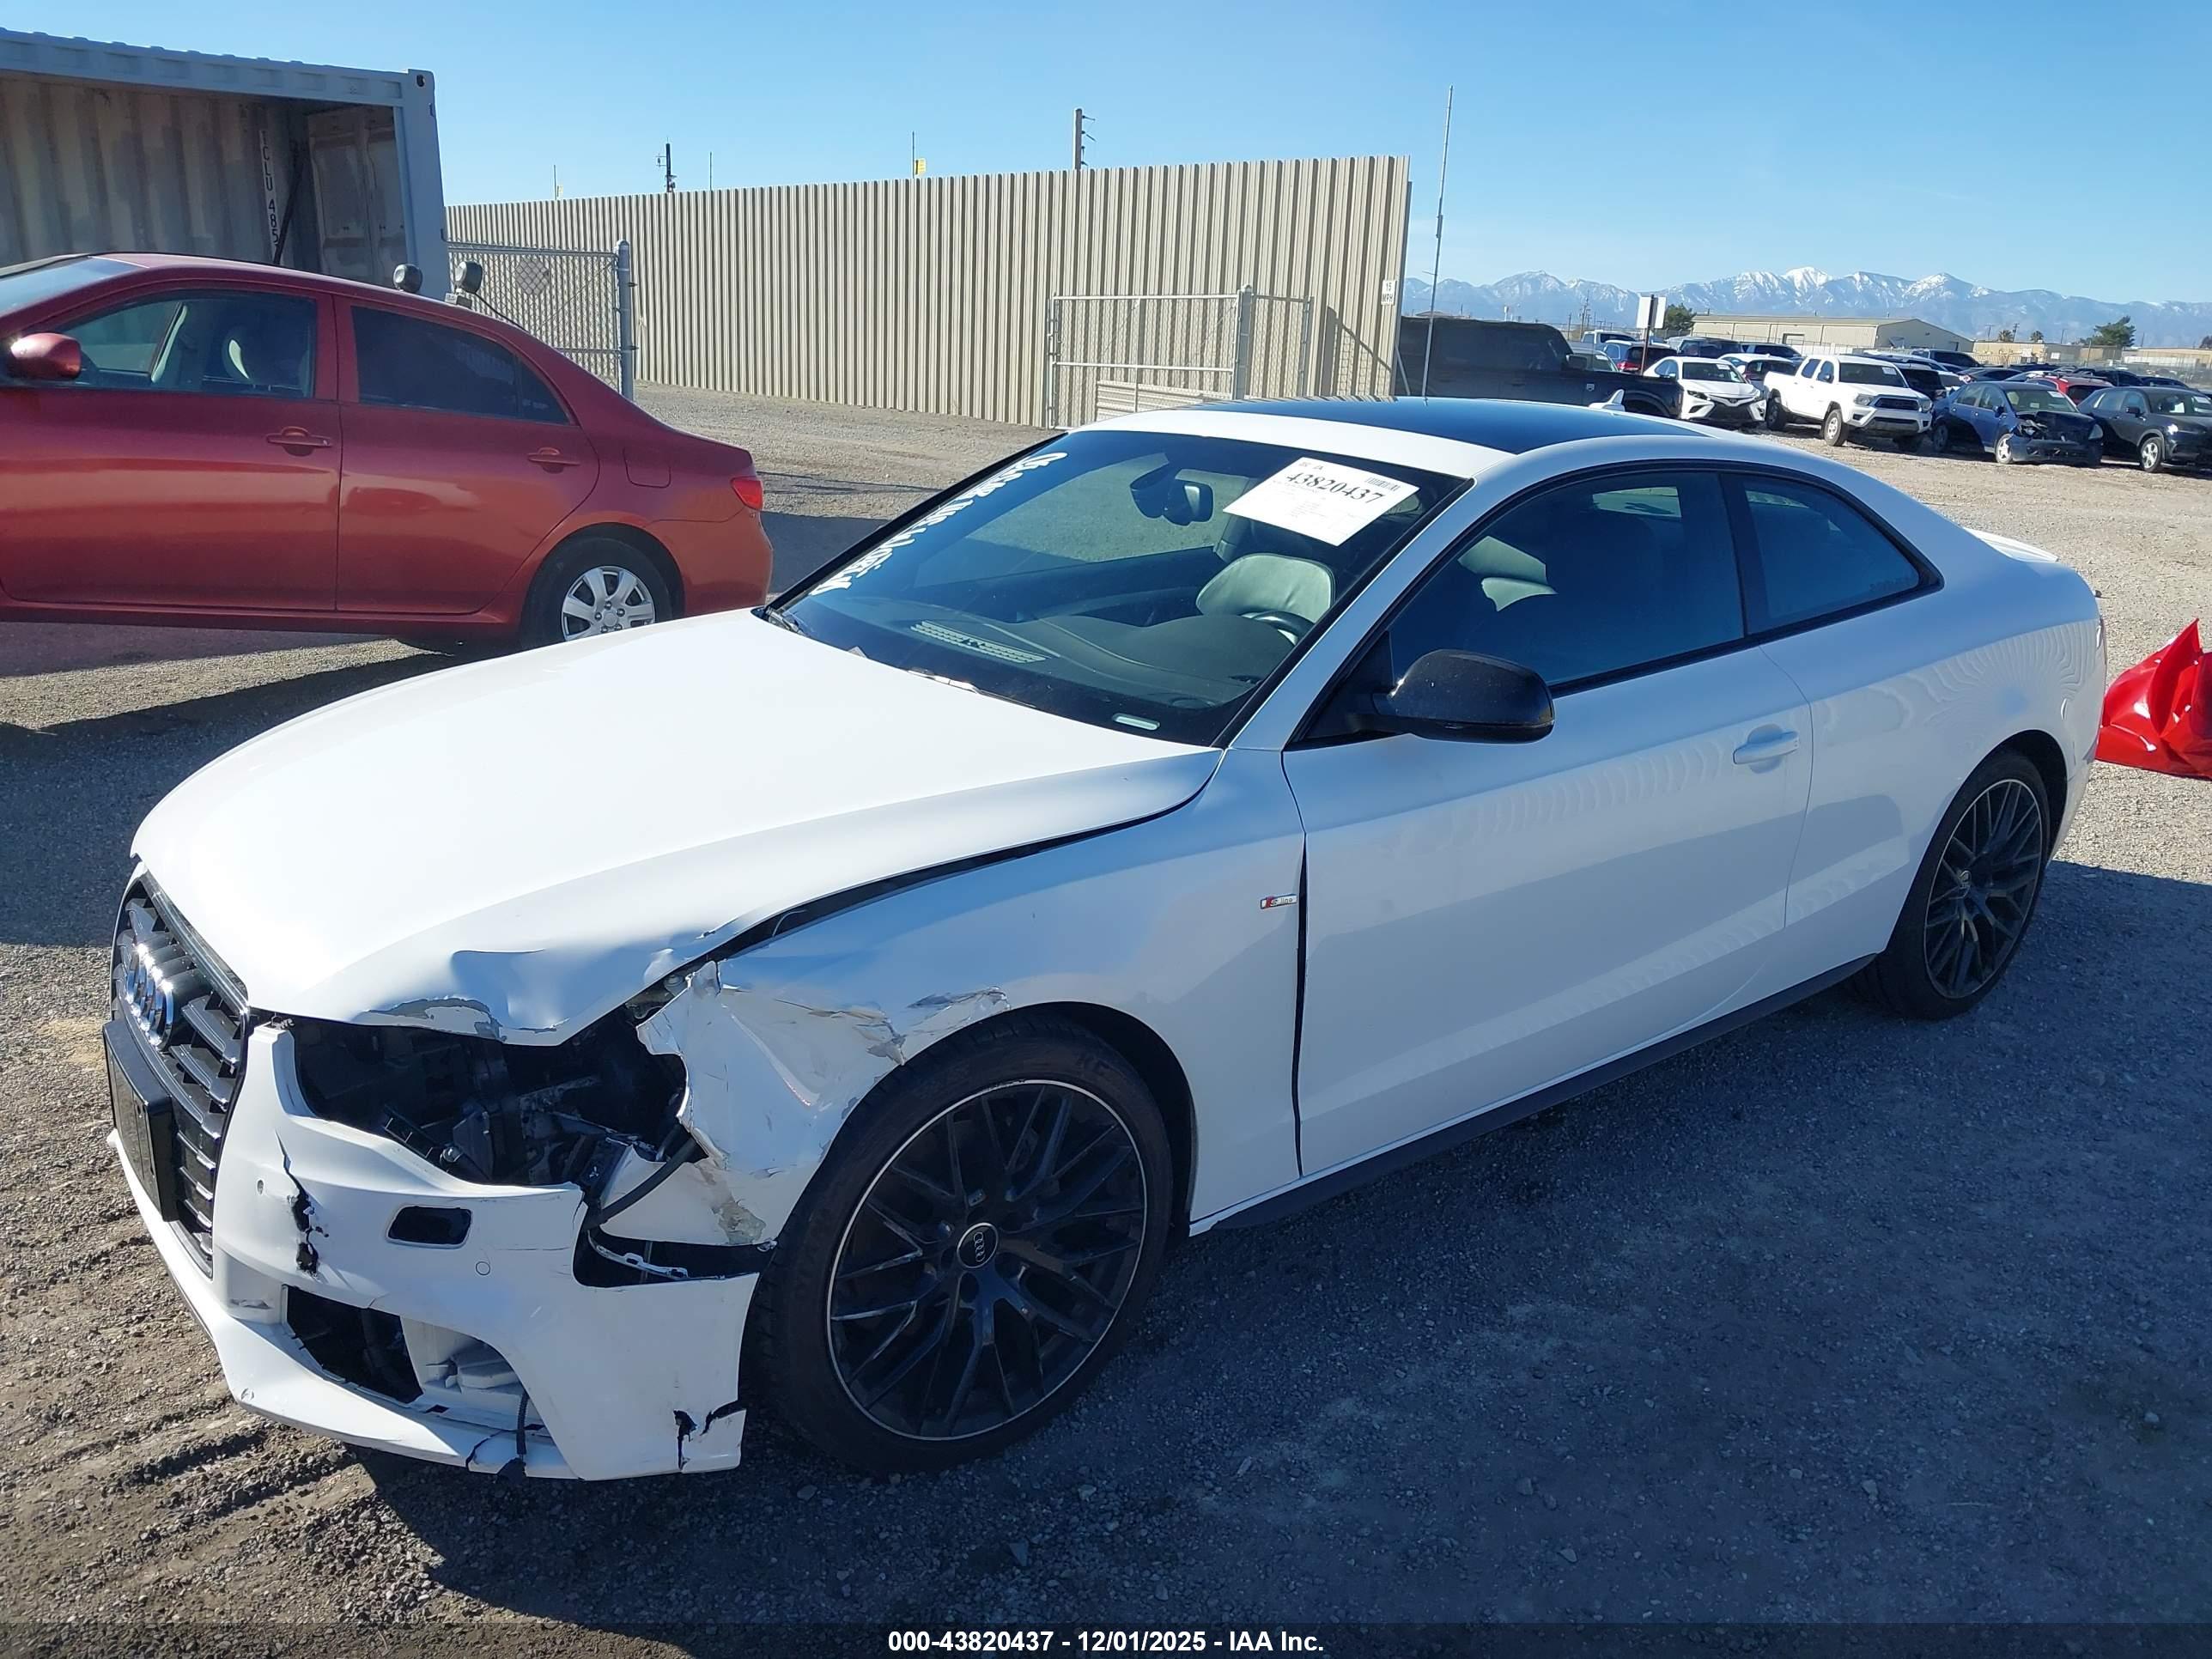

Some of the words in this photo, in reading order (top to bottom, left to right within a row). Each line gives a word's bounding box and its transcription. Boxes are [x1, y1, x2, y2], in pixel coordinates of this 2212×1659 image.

[268, 198, 280, 247] 485
[1386, 282, 1392, 292] 15
[1382, 293, 1394, 303] MPH
[1285, 471, 1386, 504] 43820437
